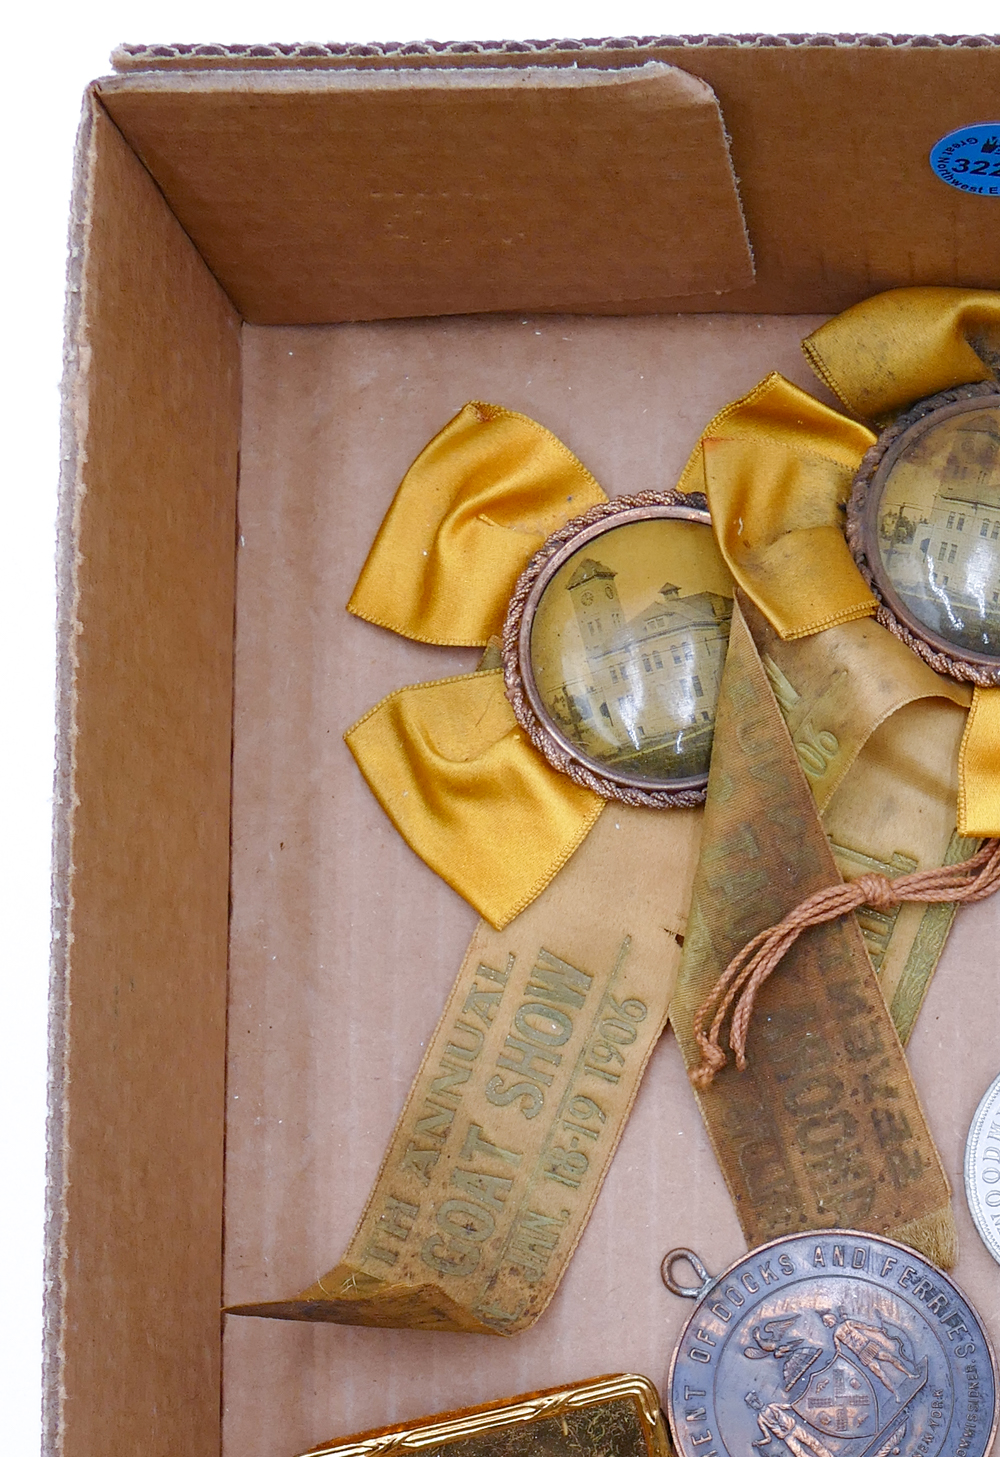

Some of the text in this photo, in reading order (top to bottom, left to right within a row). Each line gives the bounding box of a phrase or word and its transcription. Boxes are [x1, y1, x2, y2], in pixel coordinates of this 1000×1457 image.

[937, 157, 983, 194] Northwest
[945, 136, 979, 157] Great
[402, 951, 517, 1187] ANNUAL
[420, 1122, 525, 1278] GOAT
[484, 947, 595, 1120] SHOW
[504, 998, 649, 1283] JAN. 18-19 1906
[689, 1328, 718, 1364] OF
[713, 1254, 795, 1323] DOCKS
[813, 1244, 867, 1269] AND
[879, 1257, 976, 1359] FERRIES
[929, 1386, 946, 1432] YORK
